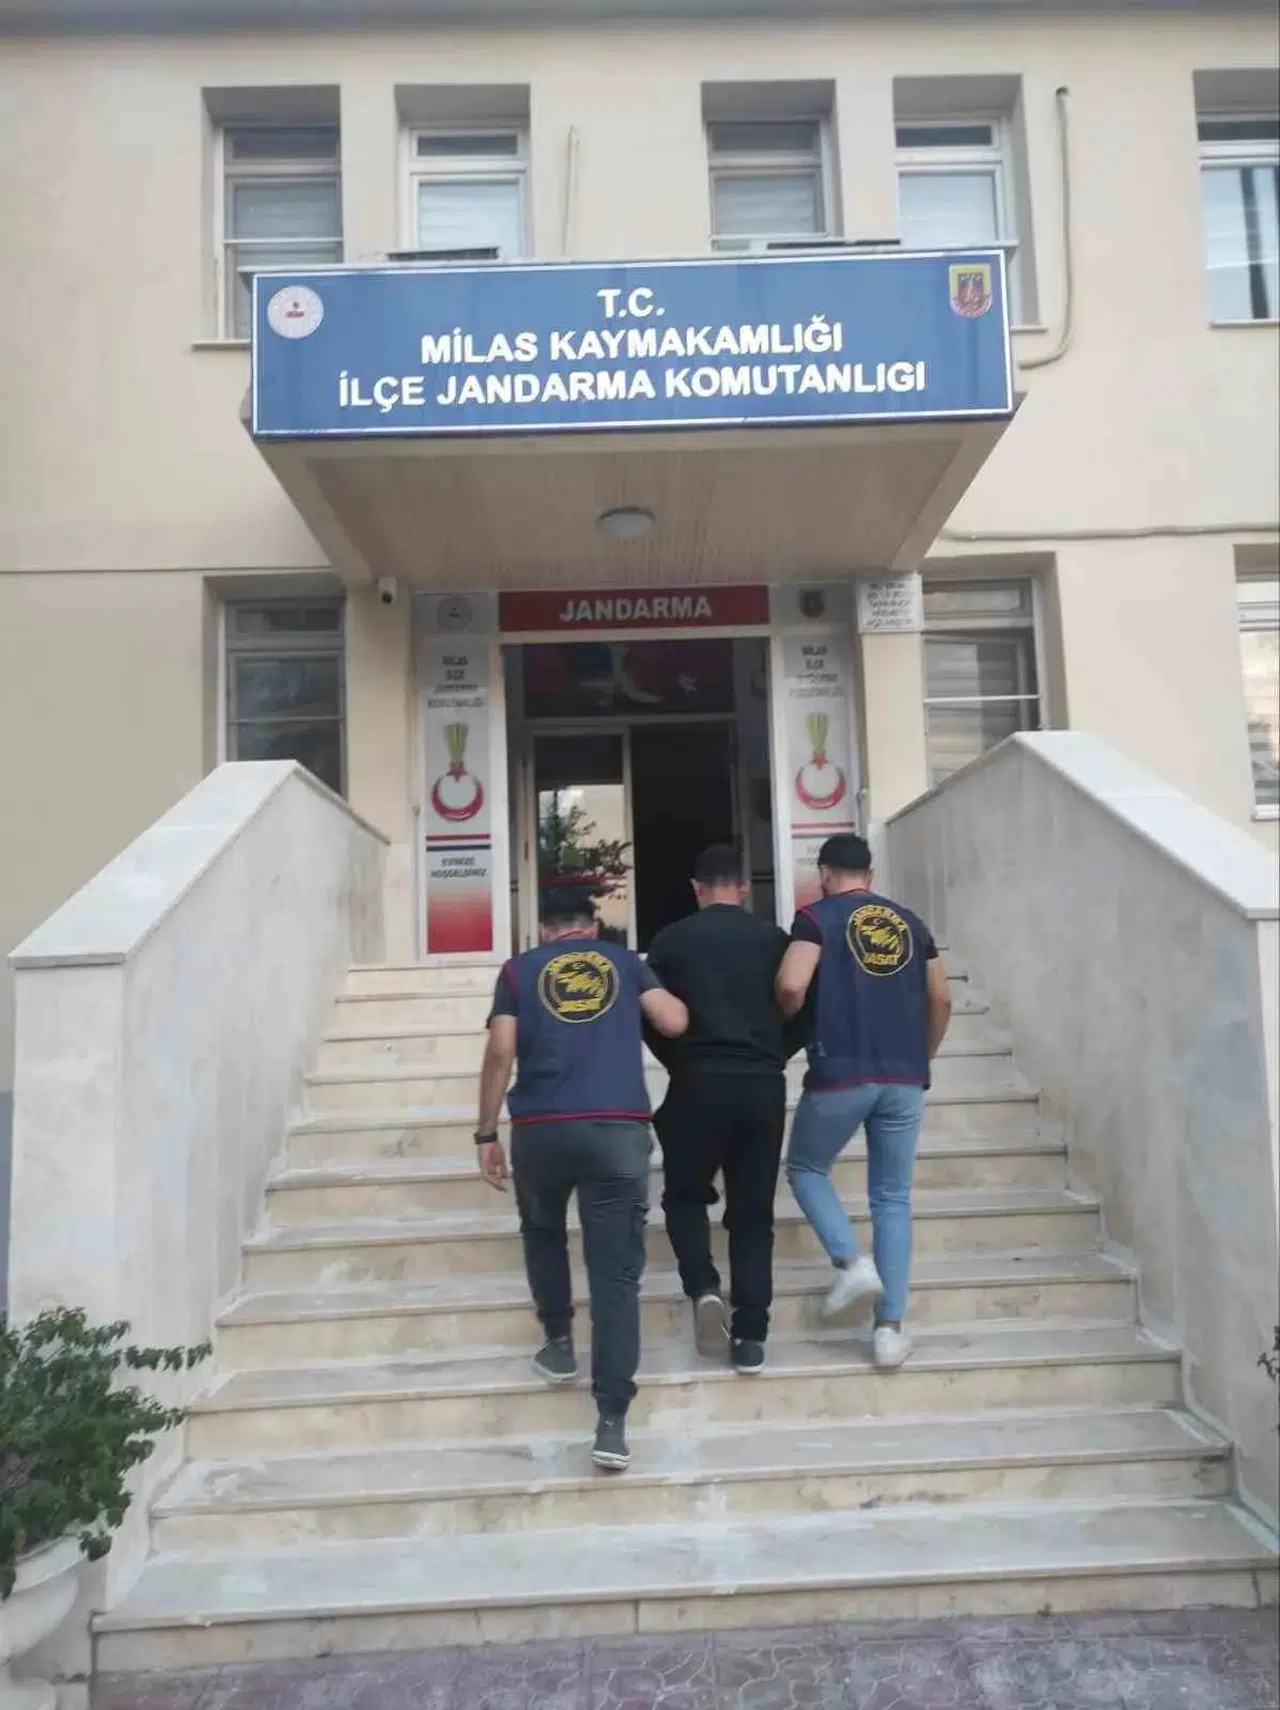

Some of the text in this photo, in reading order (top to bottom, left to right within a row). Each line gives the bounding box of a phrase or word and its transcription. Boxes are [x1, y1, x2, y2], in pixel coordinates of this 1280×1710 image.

[596, 286, 665, 318] T.C.
[420, 313, 843, 364] MİLAS KAYMAKAMLIĞI
[338, 370, 425, 413] İLÇE
[436, 368, 657, 406] JANDARMA
[559, 596, 713, 622] JANDARMA
